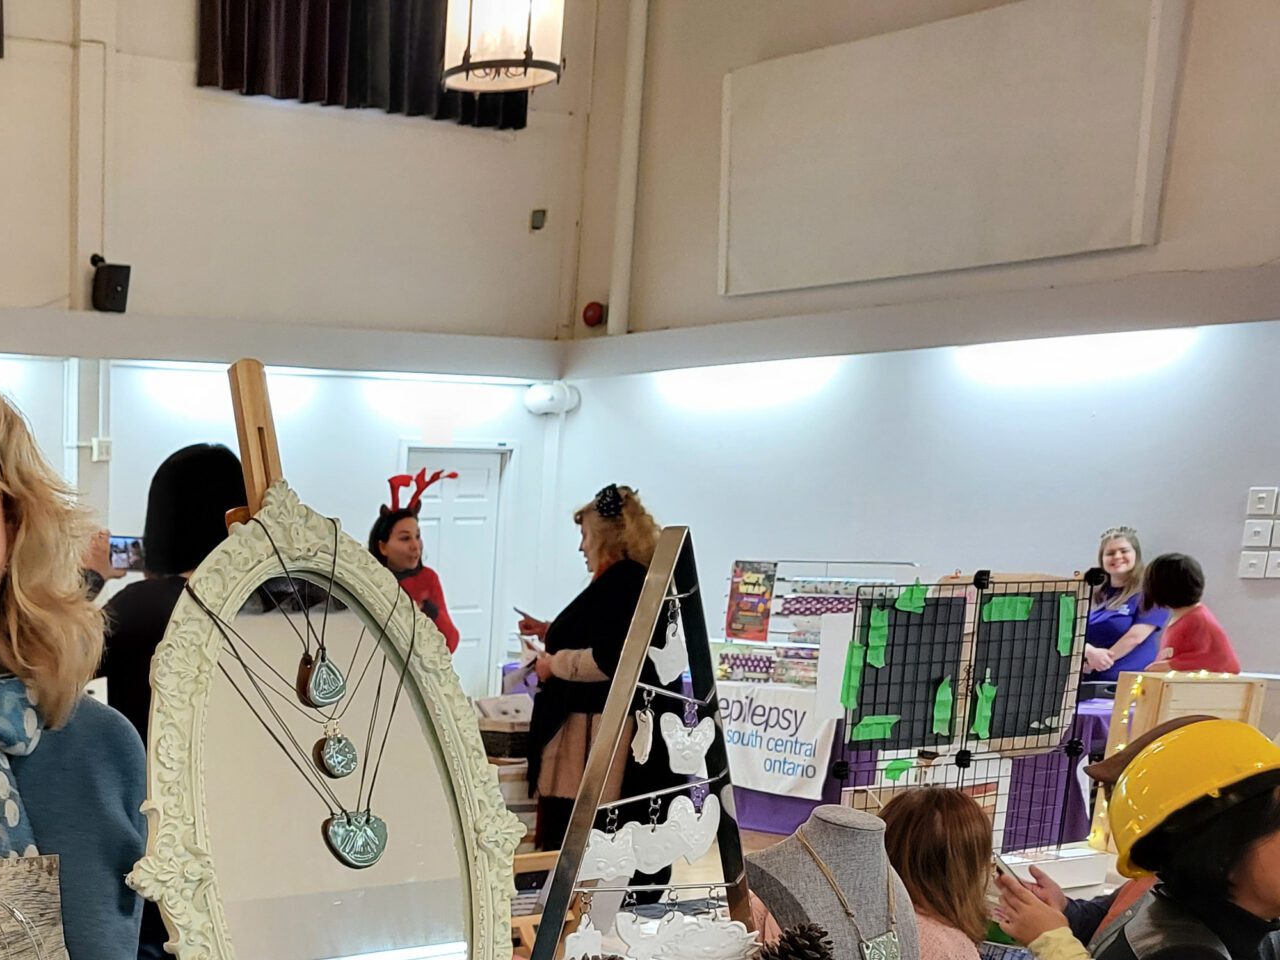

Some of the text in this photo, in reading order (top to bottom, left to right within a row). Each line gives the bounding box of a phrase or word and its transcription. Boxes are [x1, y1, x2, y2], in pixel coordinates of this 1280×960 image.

[719, 695, 807, 737] epilepsy
[726, 728, 818, 758] south central
[763, 757, 817, 779] ontario
